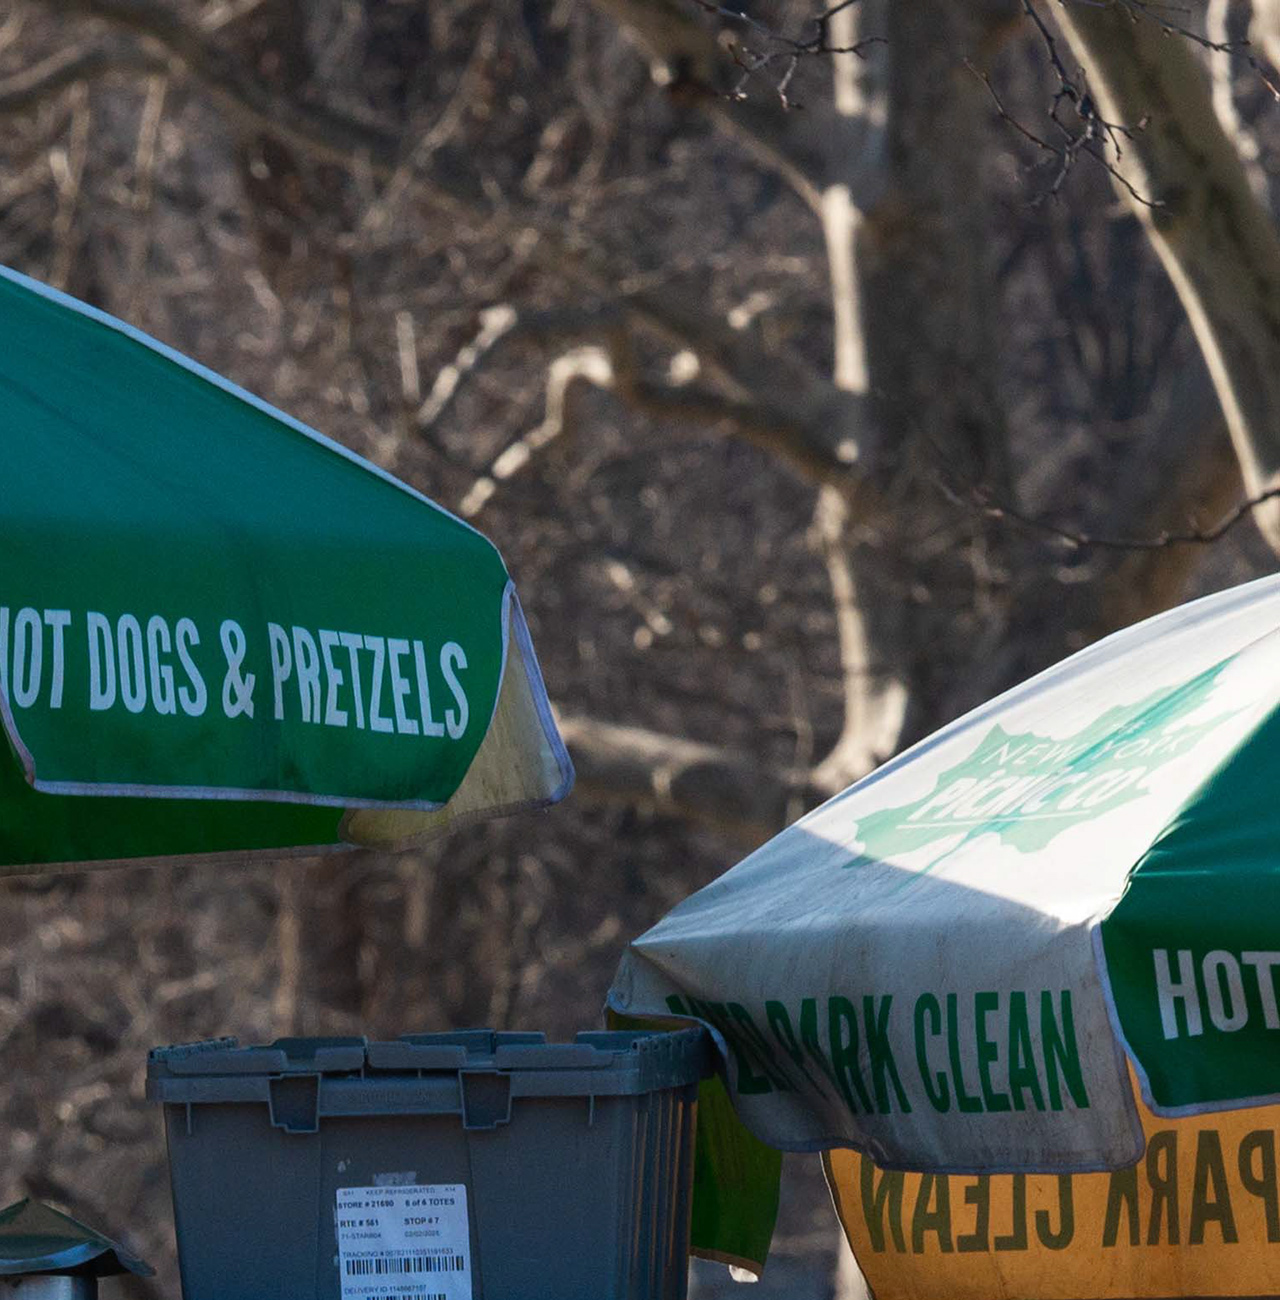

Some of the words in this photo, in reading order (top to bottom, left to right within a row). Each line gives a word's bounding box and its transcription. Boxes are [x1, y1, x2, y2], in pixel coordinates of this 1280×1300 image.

[86, 610, 208, 717] DOGS
[220, 619, 255, 720] &
[267, 622, 469, 740] PRETZELS
[982, 742, 1084, 766] NEW
[1152, 948, 1280, 1041] HOT
[765, 994, 912, 1115] PARK
[913, 991, 1089, 1115] CLEAN
[429, 1198, 455, 1206] TOTES
